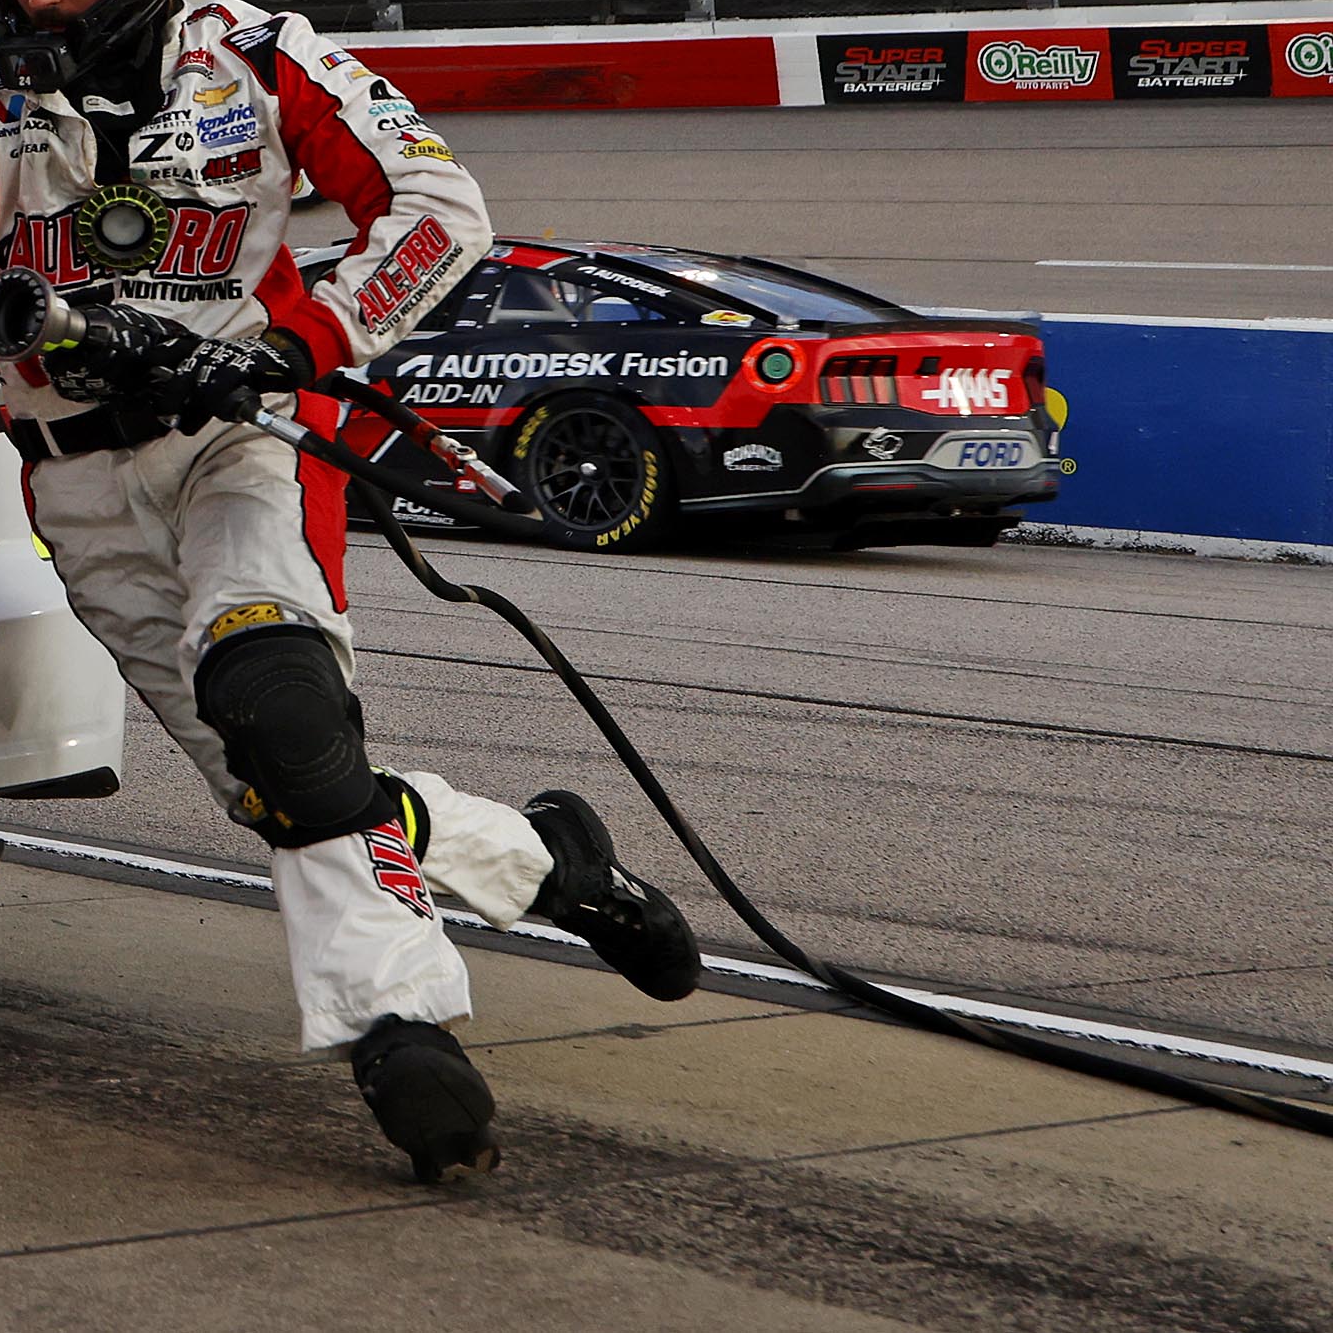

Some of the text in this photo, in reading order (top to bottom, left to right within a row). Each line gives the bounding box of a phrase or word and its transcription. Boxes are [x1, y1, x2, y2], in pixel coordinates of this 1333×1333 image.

[845, 47, 945, 64] SUPER
[1140, 40, 1248, 57] SUPER
[834, 61, 947, 82] START
[984, 46, 1092, 79] O'Reilly
[1127, 56, 1251, 76] START
[18, 76, 32, 87] 24
[843, 81, 934, 93] BATTERIES
[1015, 81, 1070, 90] AUTO PARTS
[1137, 76, 1237, 87] BATTERIES
[132, 132, 174, 163] Z
[177, 133, 194, 150] hp
[408, 145, 453, 156] SUNOC
[354, 216, 452, 333] ALL-PRO
[591, 267, 672, 298] AUTODESK
[377, 244, 464, 337] AUTO RECONDITIONING
[435, 350, 728, 379] AUTODESK Fusion
[399, 384, 504, 405] ADD-IN
[958, 442, 1024, 467] FORD
